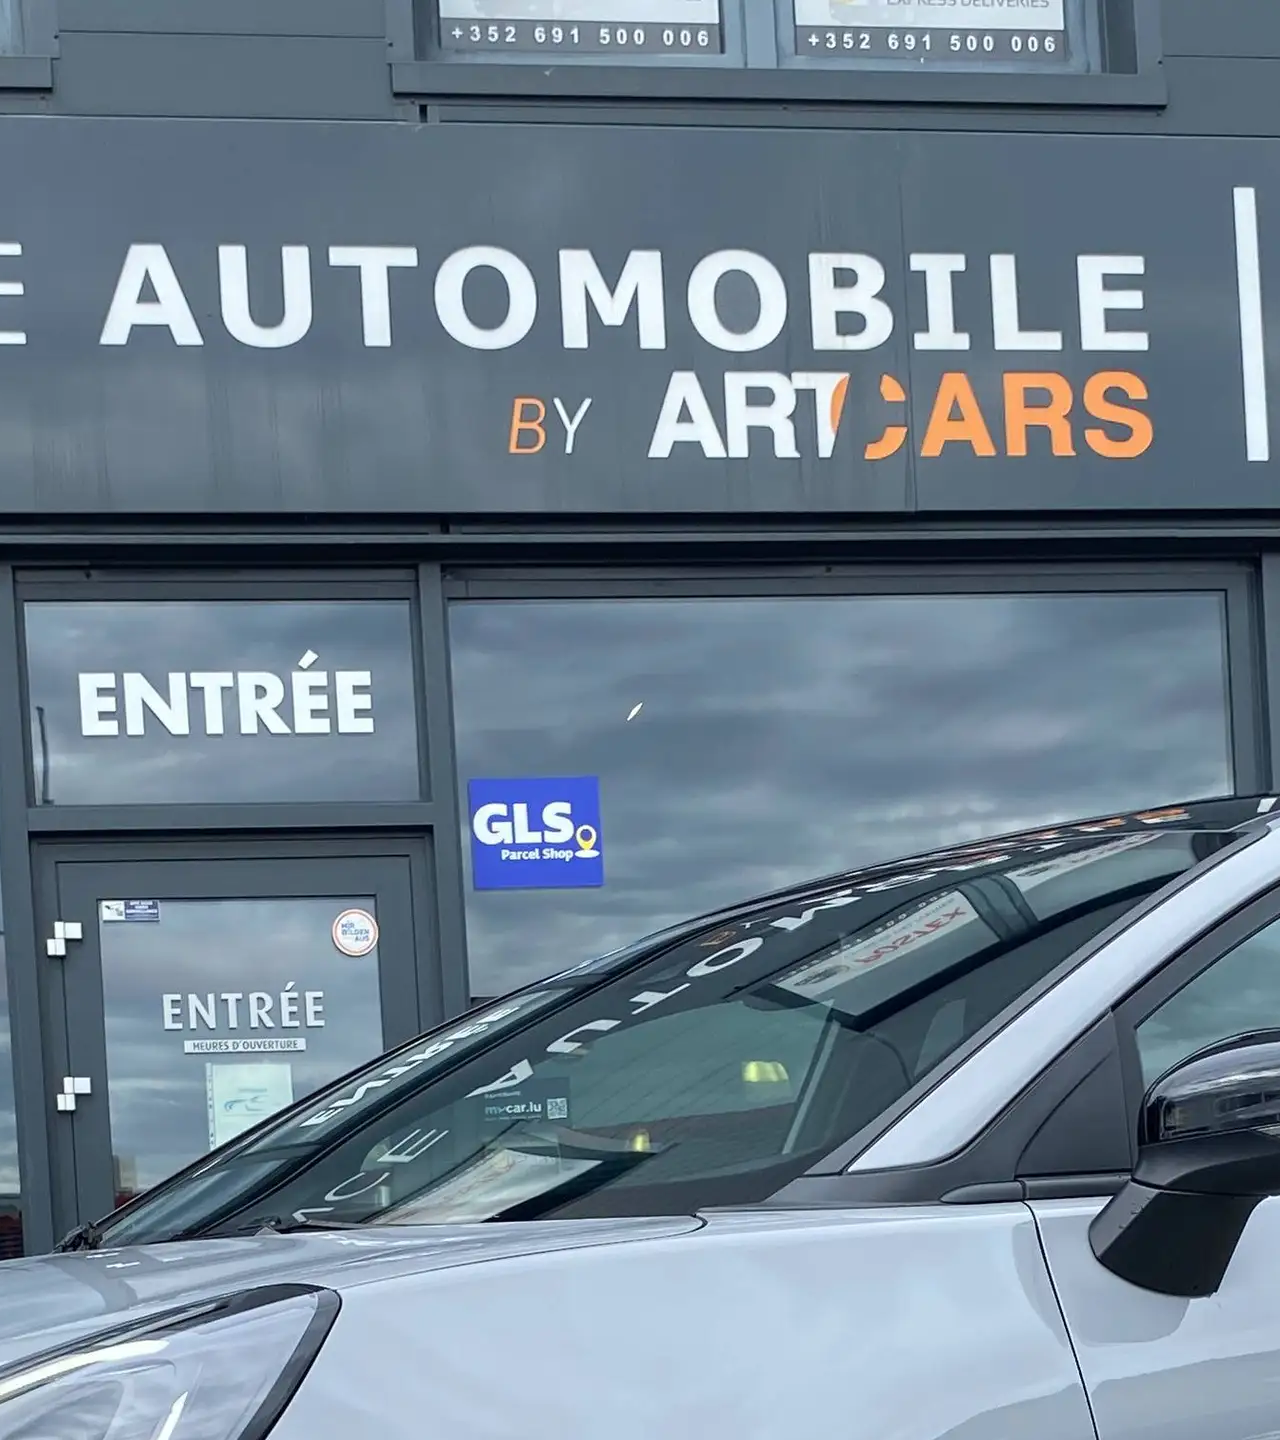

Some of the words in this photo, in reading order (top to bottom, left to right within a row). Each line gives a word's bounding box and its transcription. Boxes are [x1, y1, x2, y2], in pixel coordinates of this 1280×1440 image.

[452, 25, 517, 43] +352
[534, 26, 580, 44] 691
[599, 27, 645, 45] 500
[663, 29, 709, 46] 006
[808, 32, 871, 50] +352
[888, 33, 931, 51] 691
[950, 34, 995, 52] 500
[1012, 36, 1056, 53] 006
[99, 243, 1150, 352] AUTOMOBILE
[507, 397, 592, 455] BY
[78, 649, 375, 736] ENTRÉE
[473, 801, 575, 845] GLS
[501, 848, 540, 860] Parcel
[542, 848, 574, 861] Shop
[163, 981, 326, 1030] ENTRÉE
[193, 1041, 229, 1051] HEURES
[232, 1039, 298, 1050] D'OUVERTURE
